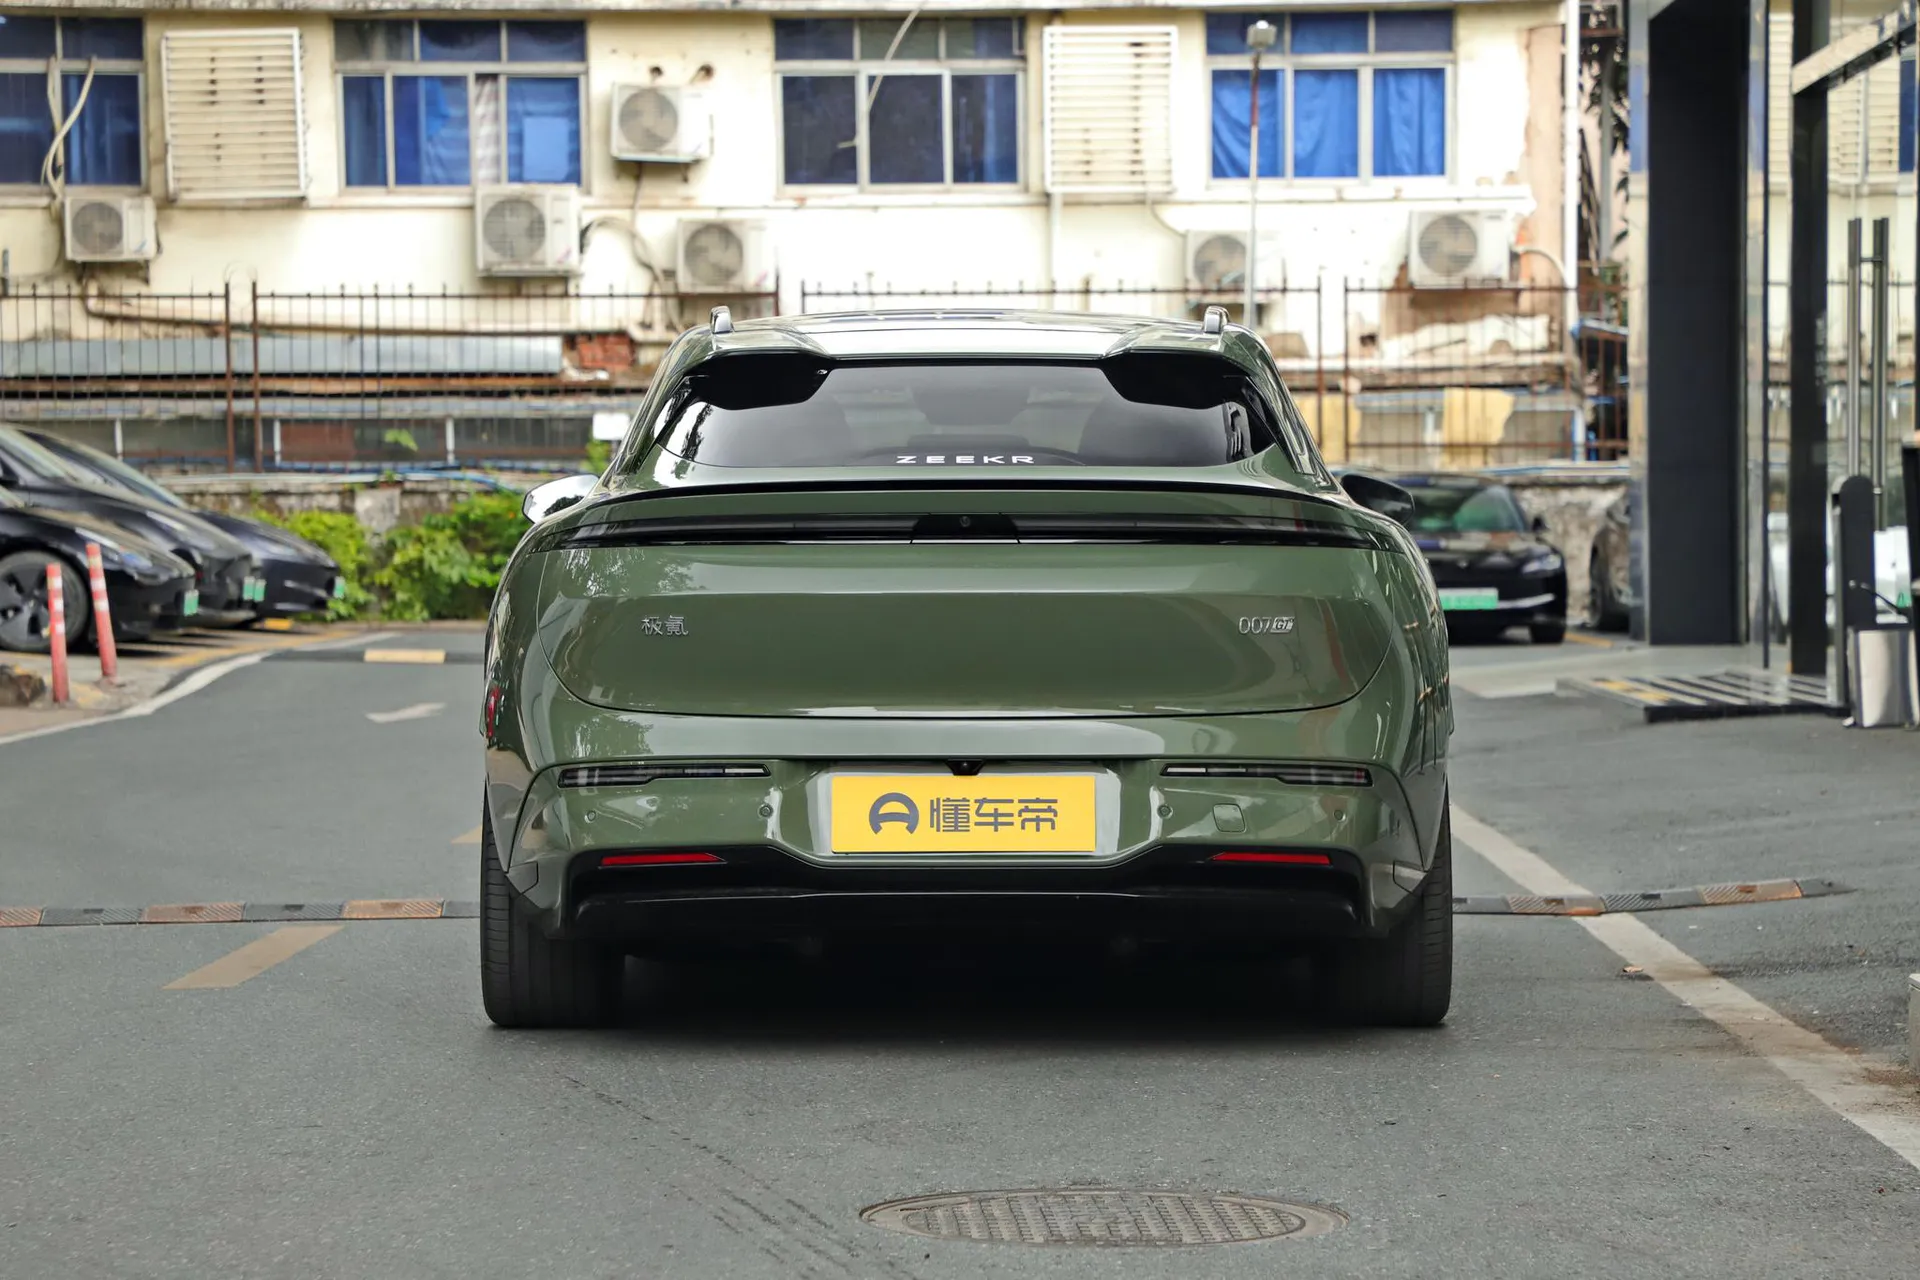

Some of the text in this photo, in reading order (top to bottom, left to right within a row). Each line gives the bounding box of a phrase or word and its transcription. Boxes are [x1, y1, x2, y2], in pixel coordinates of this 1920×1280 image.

[896, 455, 1035, 464] ZEEKR
[641, 615, 689, 636] 极氪
[929, 797, 1058, 833] 懂车帝
